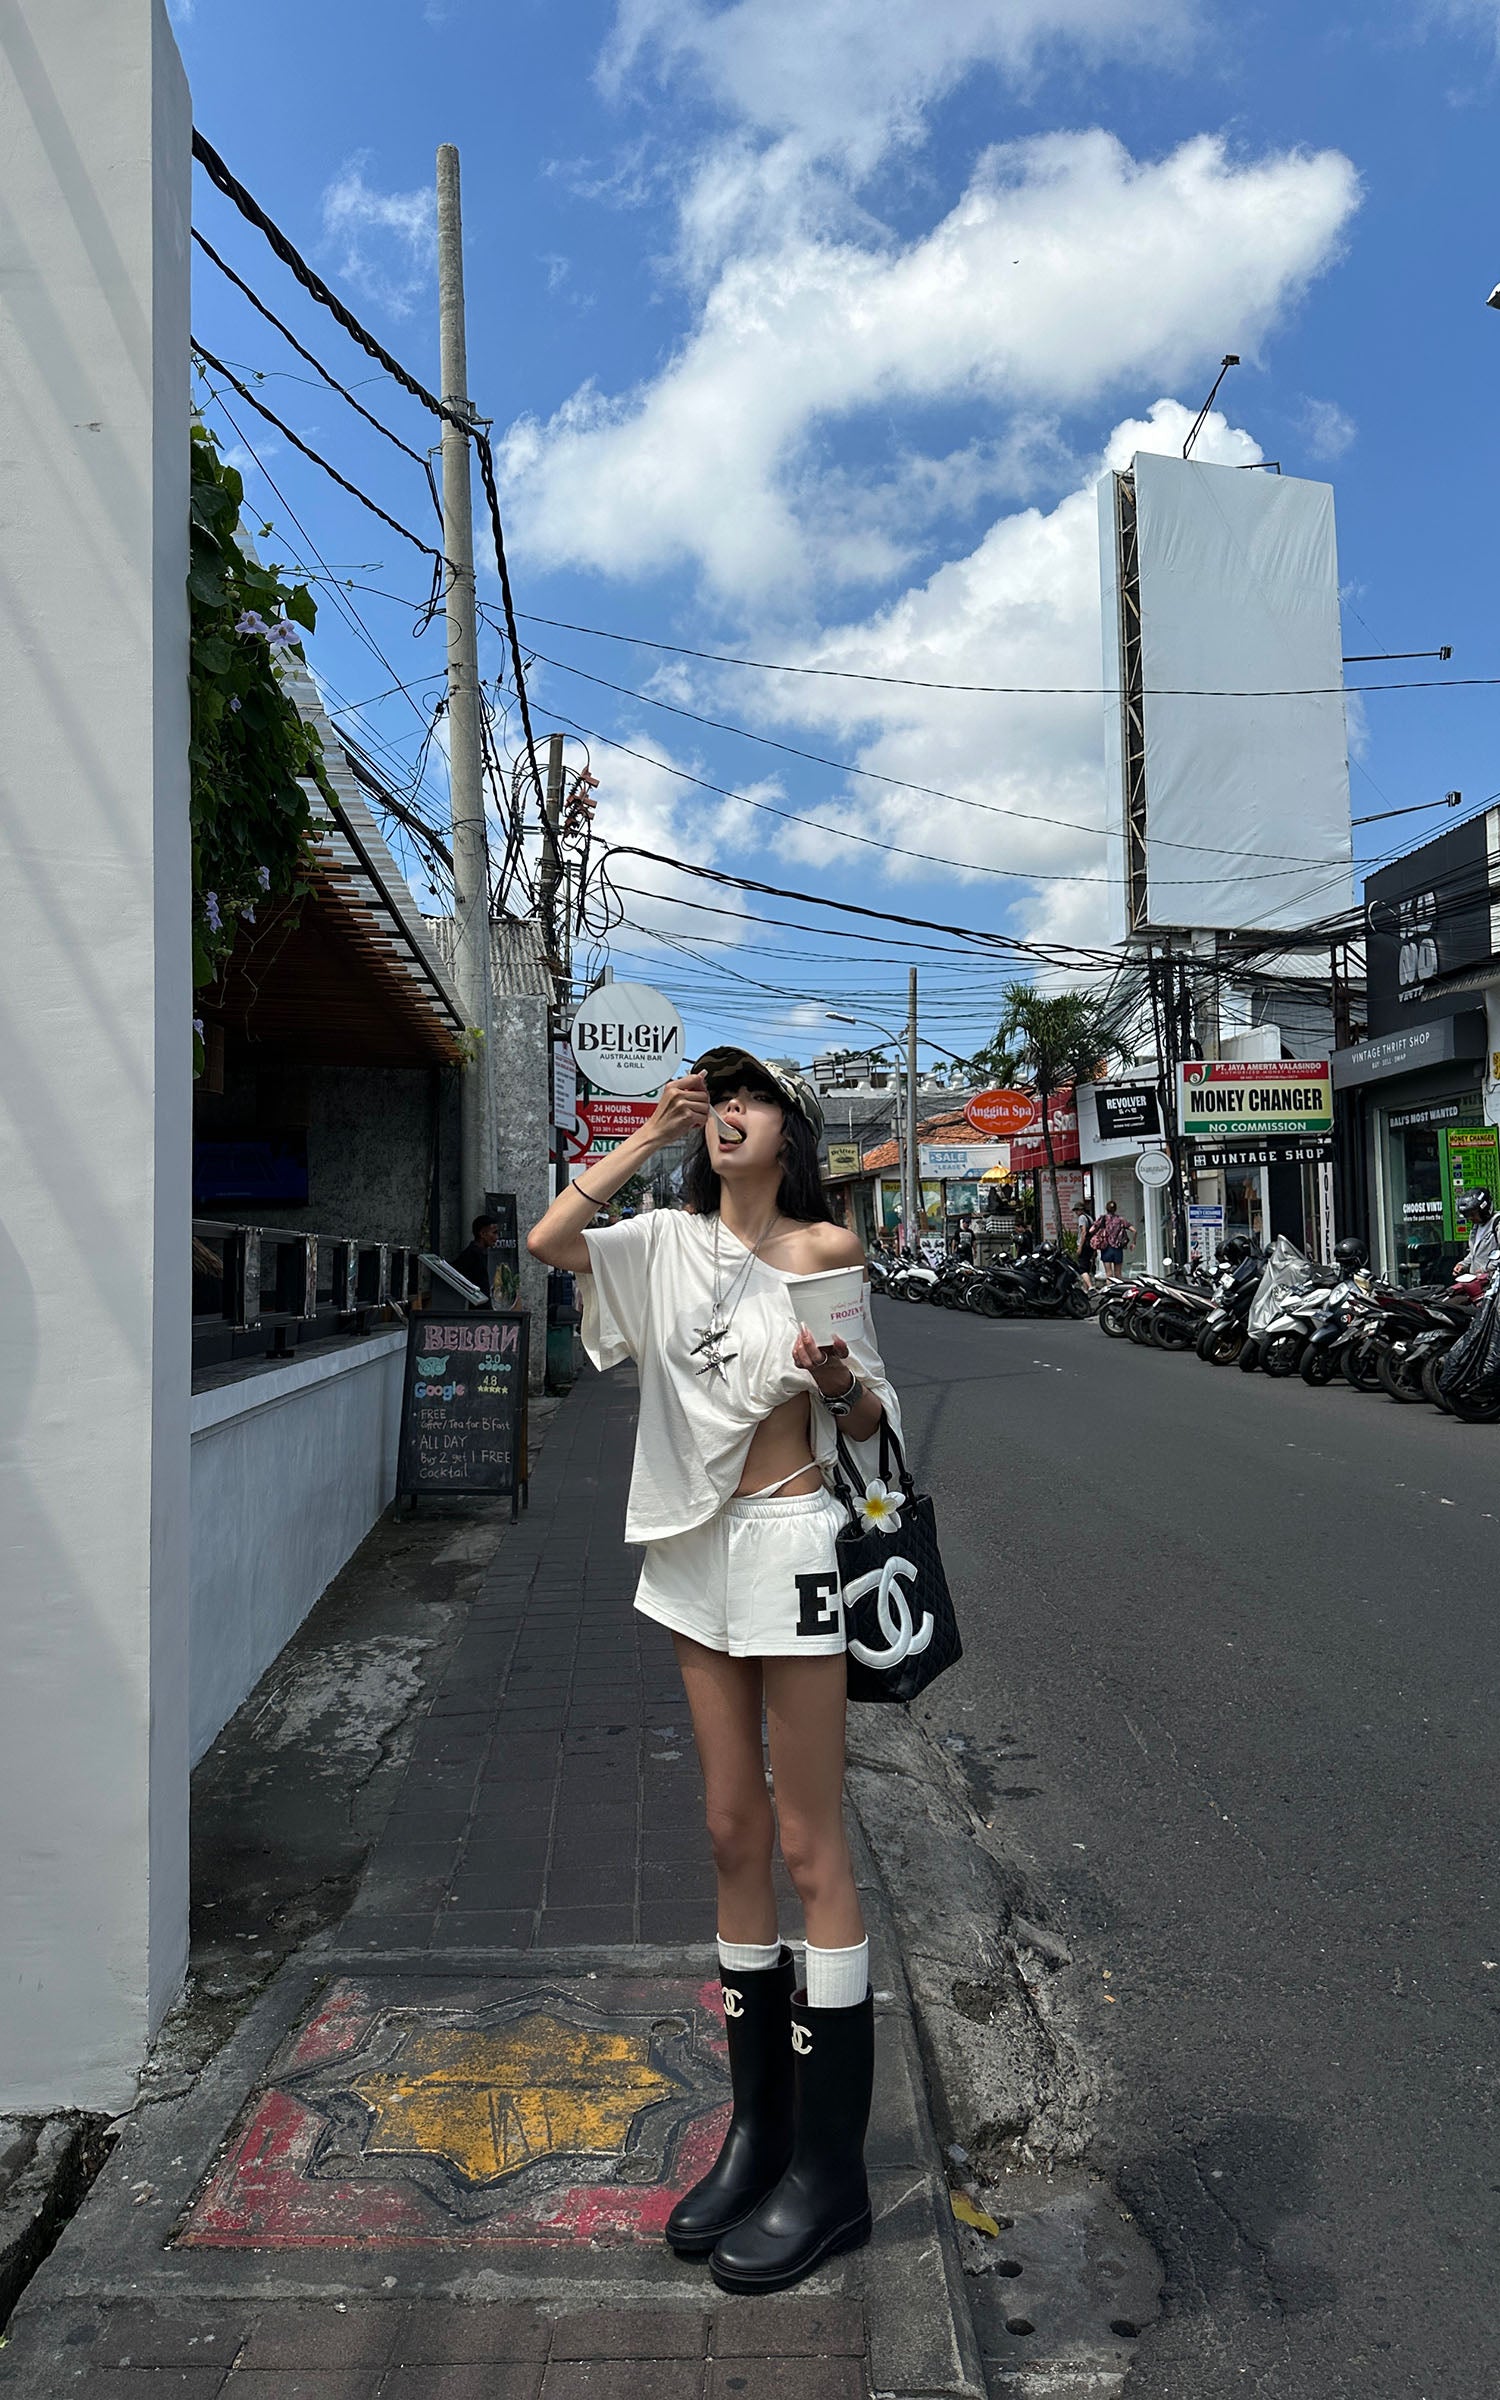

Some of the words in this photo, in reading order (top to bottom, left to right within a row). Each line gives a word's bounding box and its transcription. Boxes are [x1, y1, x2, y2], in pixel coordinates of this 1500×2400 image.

[1351, 1046, 1381, 1064] VINTAGE
[1382, 1038, 1407, 1055] THRIFT
[1409, 1031, 1431, 1048] SHOP
[599, 1053, 646, 1061] AUSTRALIAN
[646, 1054, 663, 1062] BAR
[623, 1062, 645, 1070] GRILL
[1215, 1063, 1227, 1072] PT.
[1228, 1063, 1246, 1072] JAYA
[1247, 1062, 1277, 1071] AMERTA
[1278, 1061, 1322, 1070] VALASINDO
[1106, 1095, 1148, 1110] REVOLVER
[1190, 1089, 1245, 1113] MONEY
[1248, 1087, 1323, 1112] CHANGER
[593, 1104, 603, 1113] 24
[604, 1104, 632, 1114] HOURS
[971, 1105, 1009, 1120] Anggita
[1012, 1104, 1032, 1119] Spa
[1389, 1114, 1410, 1128] BALI'S
[1410, 1111, 1429, 1125] MOST
[1429, 1105, 1459, 1121] WANTED
[1208, 1123, 1227, 1133] NO
[1230, 1121, 1307, 1132] COMMISSION
[935, 1152, 966, 1162] SALE
[1211, 1151, 1278, 1165] VINTAGE
[1285, 1148, 1325, 1161] SHOP
[1402, 1202, 1426, 1214] CHOOSE
[485, 1354, 501, 1365] 5.0
[483, 1375, 498, 1387] 4.8
[414, 1381, 466, 1402] Google
[420, 1408, 447, 1420] FREE
[465, 1416, 480, 1431] for
[420, 1434, 440, 1450] ALL
[443, 1434, 468, 1449] DAY
[439, 1451, 448, 1464] 2
[481, 1449, 512, 1464] FREE
[795, 1571, 839, 1637] E
